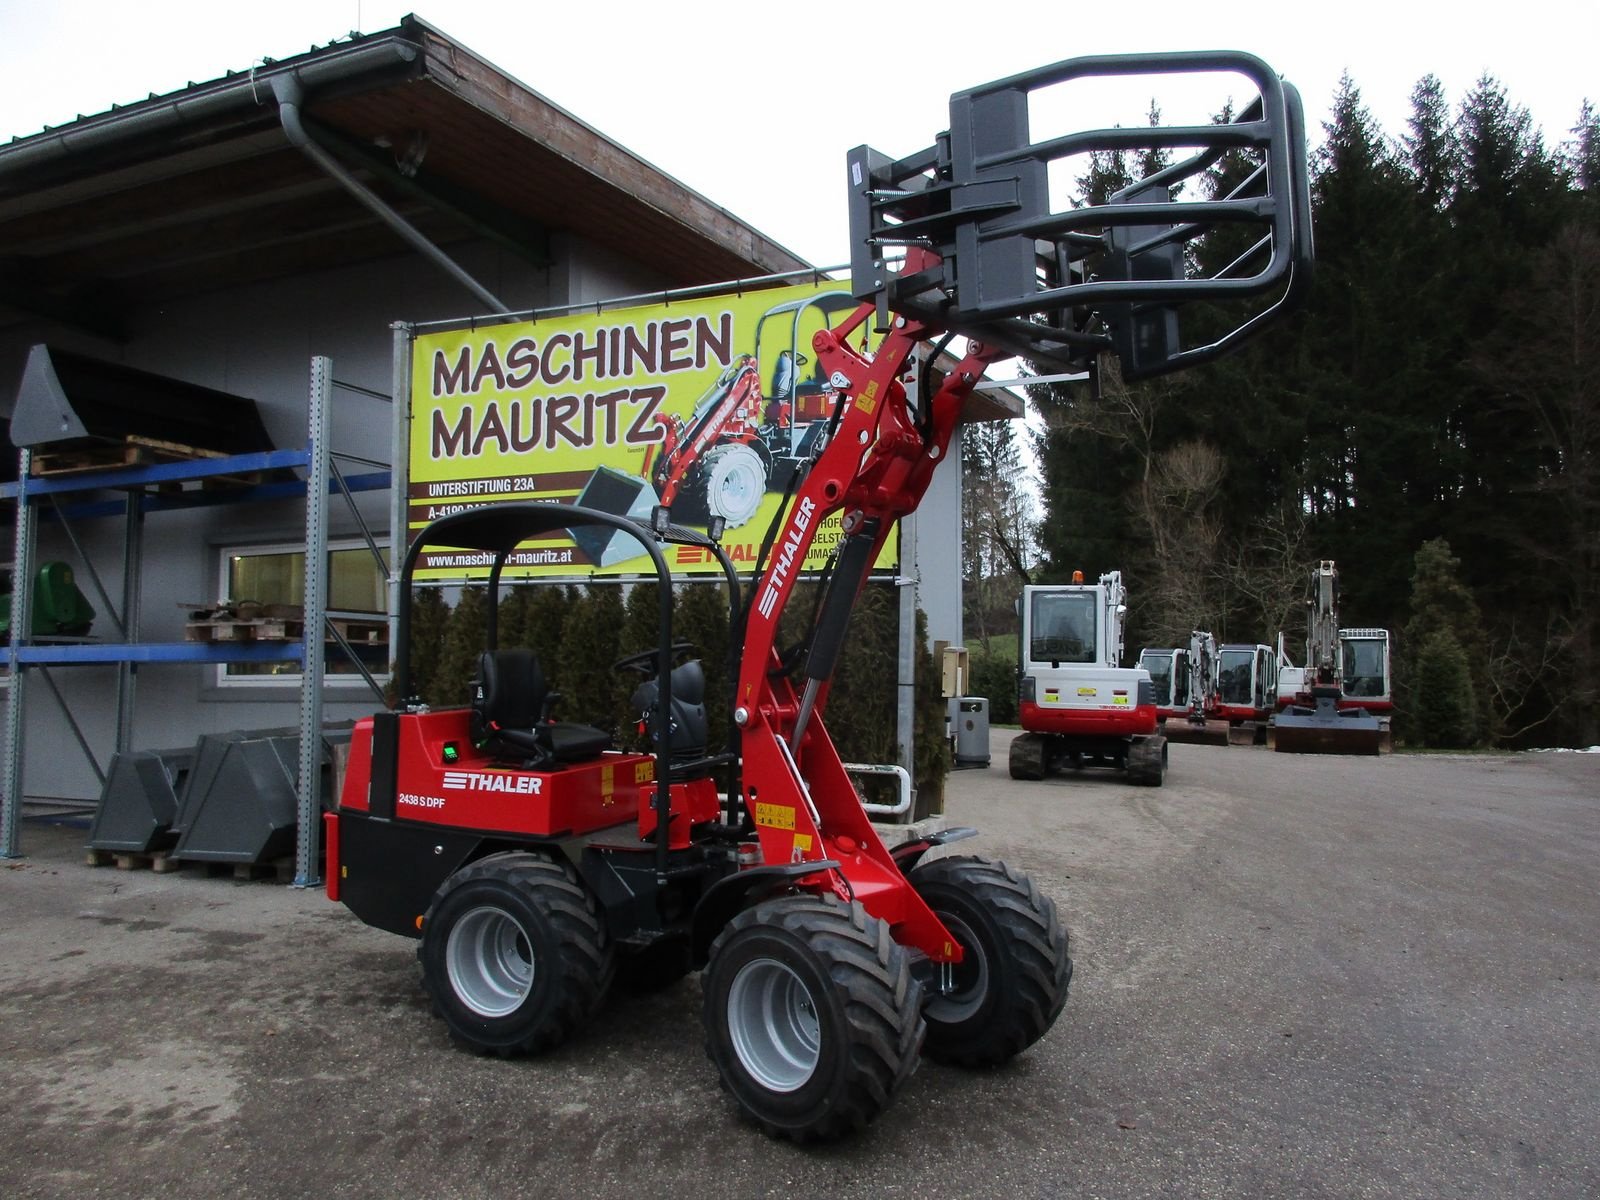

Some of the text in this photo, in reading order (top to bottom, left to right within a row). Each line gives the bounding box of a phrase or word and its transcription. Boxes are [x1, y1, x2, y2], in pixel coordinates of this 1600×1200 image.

[433, 314, 732, 396] MASCHINEN
[432, 386, 667, 458] MAURITZ
[429, 477, 535, 496] UNTERSTIFTUNG 23A
[768, 496, 816, 590] THALER
[427, 550, 572, 567] www.maschinn-mauritz.at
[468, 774, 542, 794] THALER
[399, 793, 446, 809] 2438 S DPF
